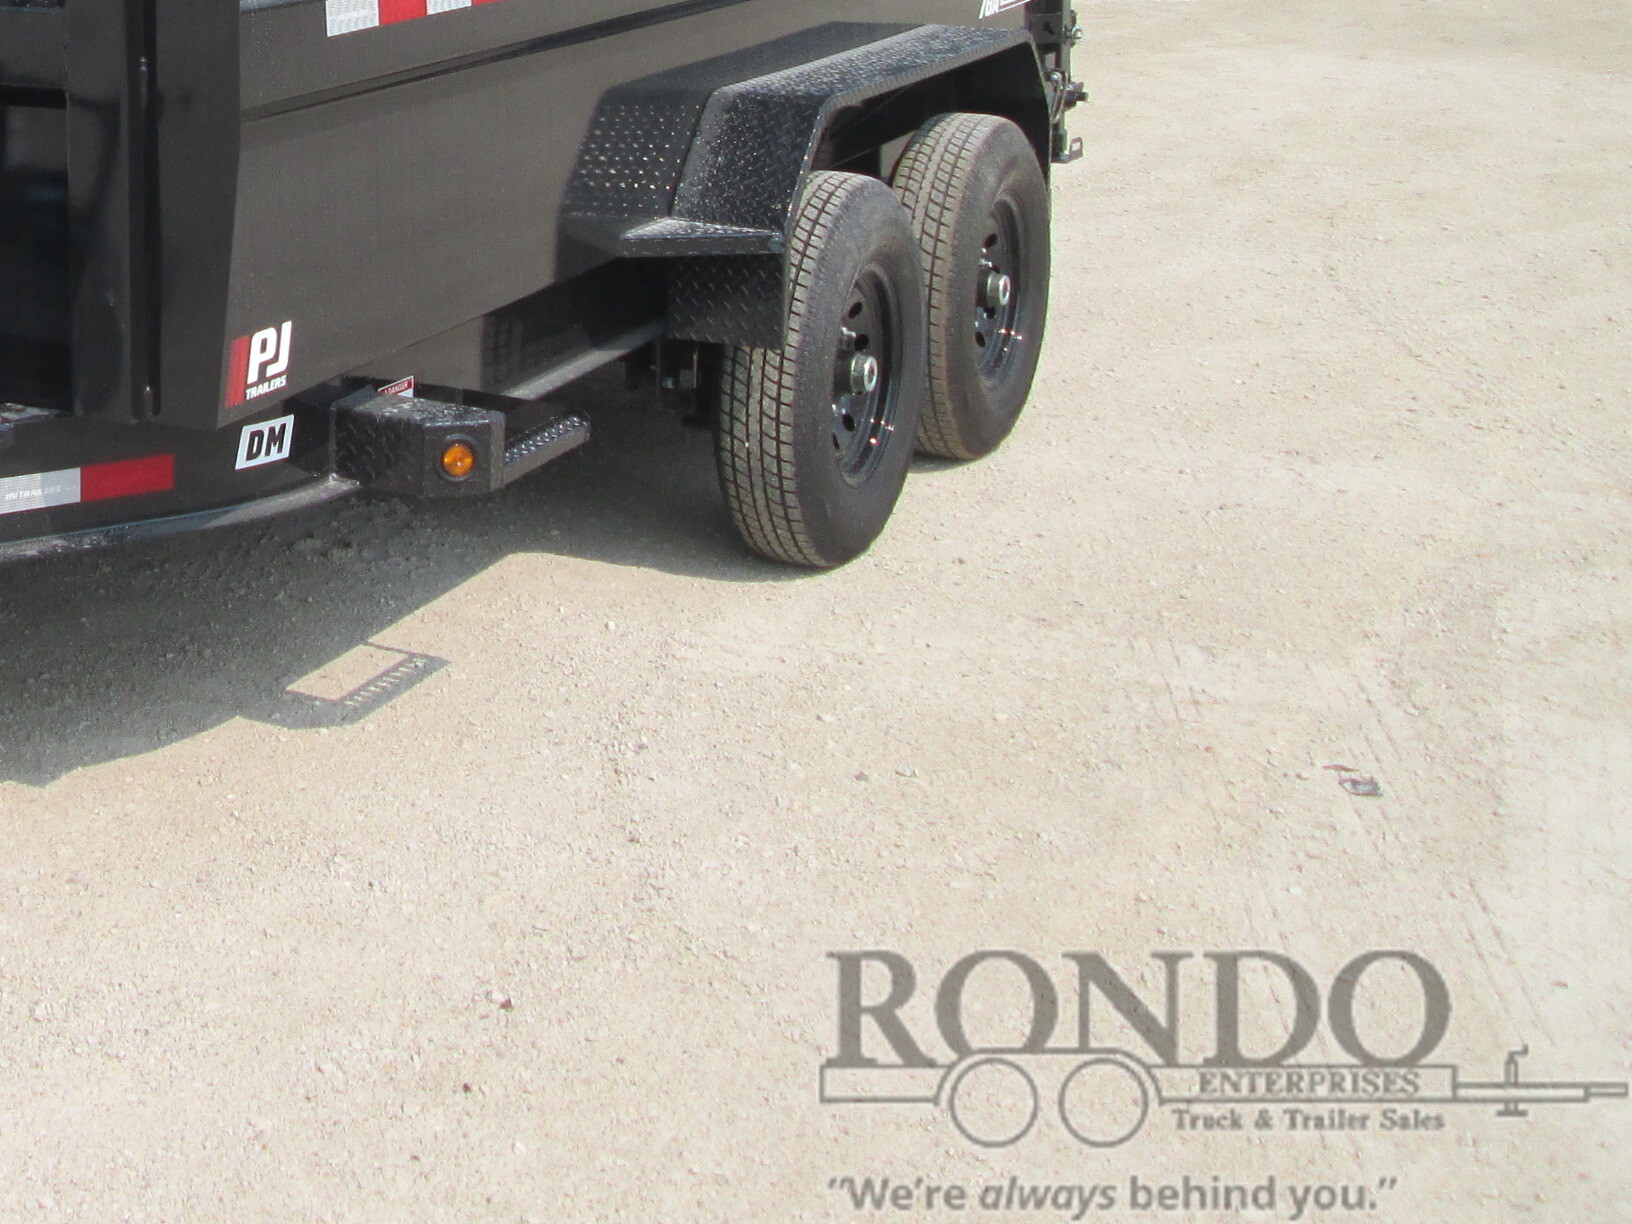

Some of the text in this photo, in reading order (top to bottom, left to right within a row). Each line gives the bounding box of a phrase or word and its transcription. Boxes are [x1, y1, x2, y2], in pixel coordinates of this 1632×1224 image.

[247, 320, 292, 384] PJ
[246, 375, 287, 401] TRAILERS
[245, 422, 287, 462] DM
